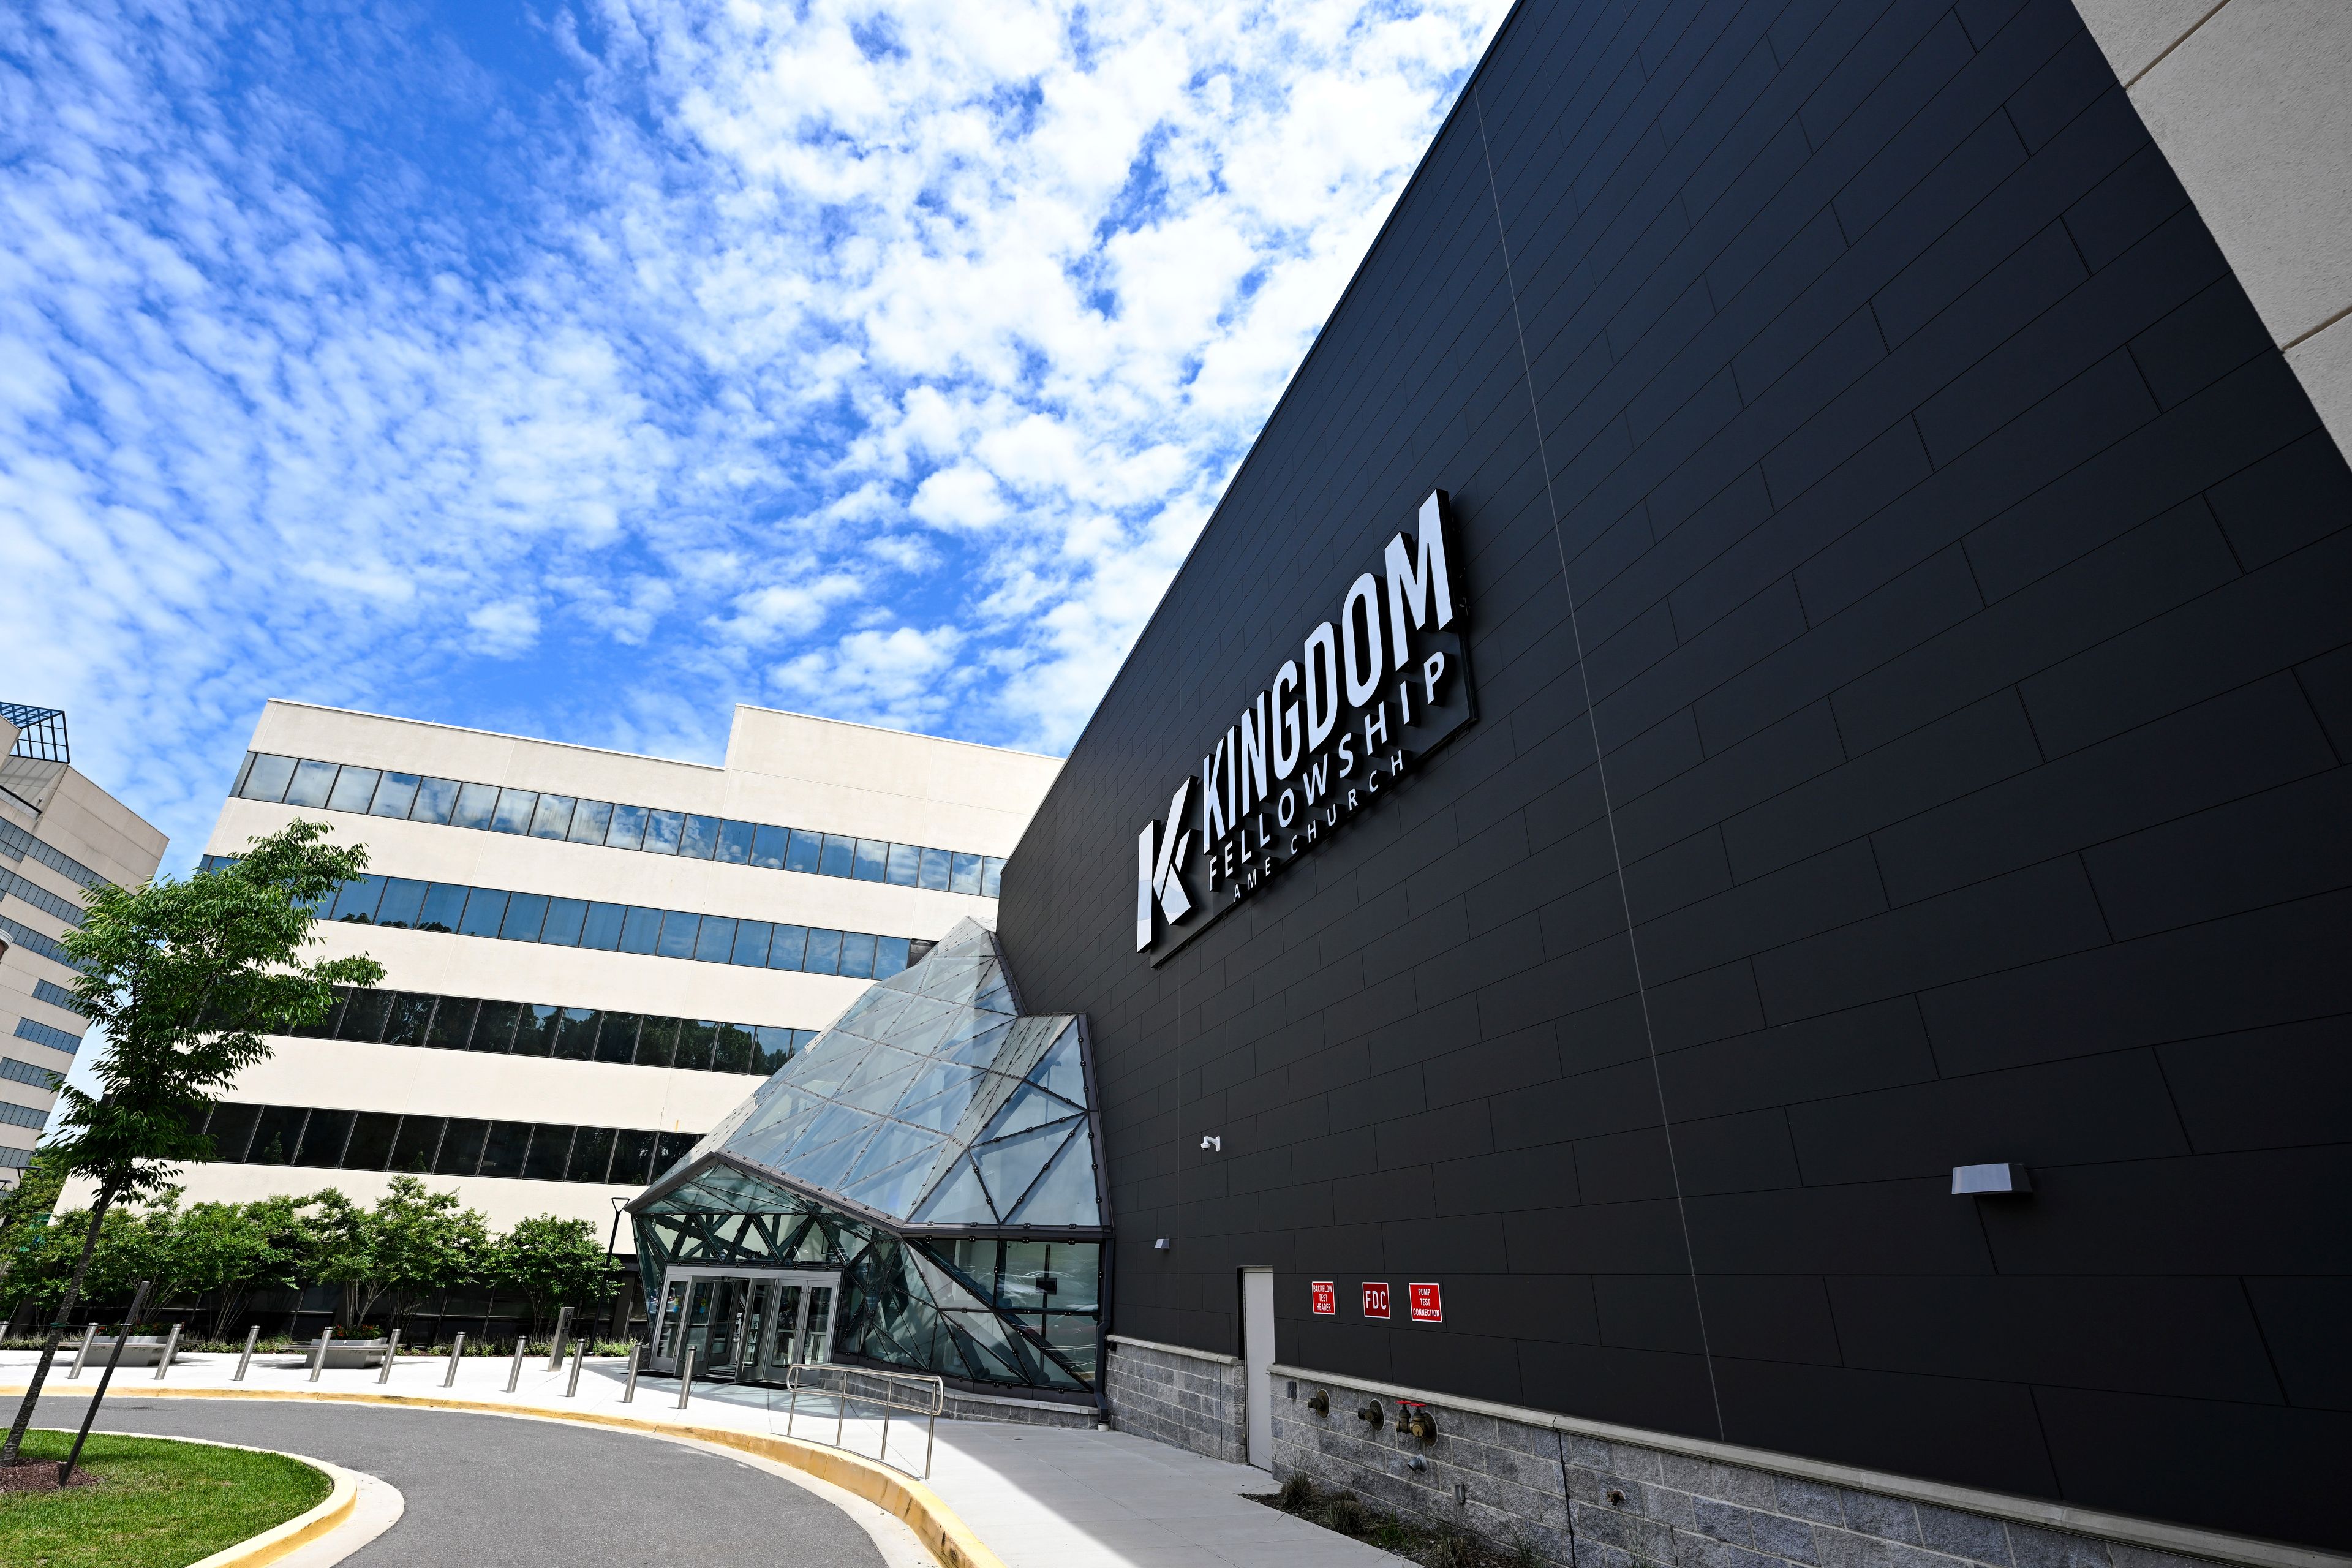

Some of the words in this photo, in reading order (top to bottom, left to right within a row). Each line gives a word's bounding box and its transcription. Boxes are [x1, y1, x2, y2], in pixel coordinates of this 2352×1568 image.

[1203, 489, 1453, 855] KINGDOM
[1208, 651, 1446, 892] FELLOWSHIP
[1233, 857, 1271, 903] AME
[1290, 748, 1404, 855] CHURCH
[1136, 775, 1192, 954] K
[1313, 1284, 1333, 1293] BACKFLOW
[1318, 1294, 1328, 1302] TEST
[1365, 1290, 1387, 1310] FDC
[1420, 1298, 1431, 1306] TEST
[1316, 1303, 1332, 1311] HEADER
[1412, 1308, 1440, 1317] CONNECTION
